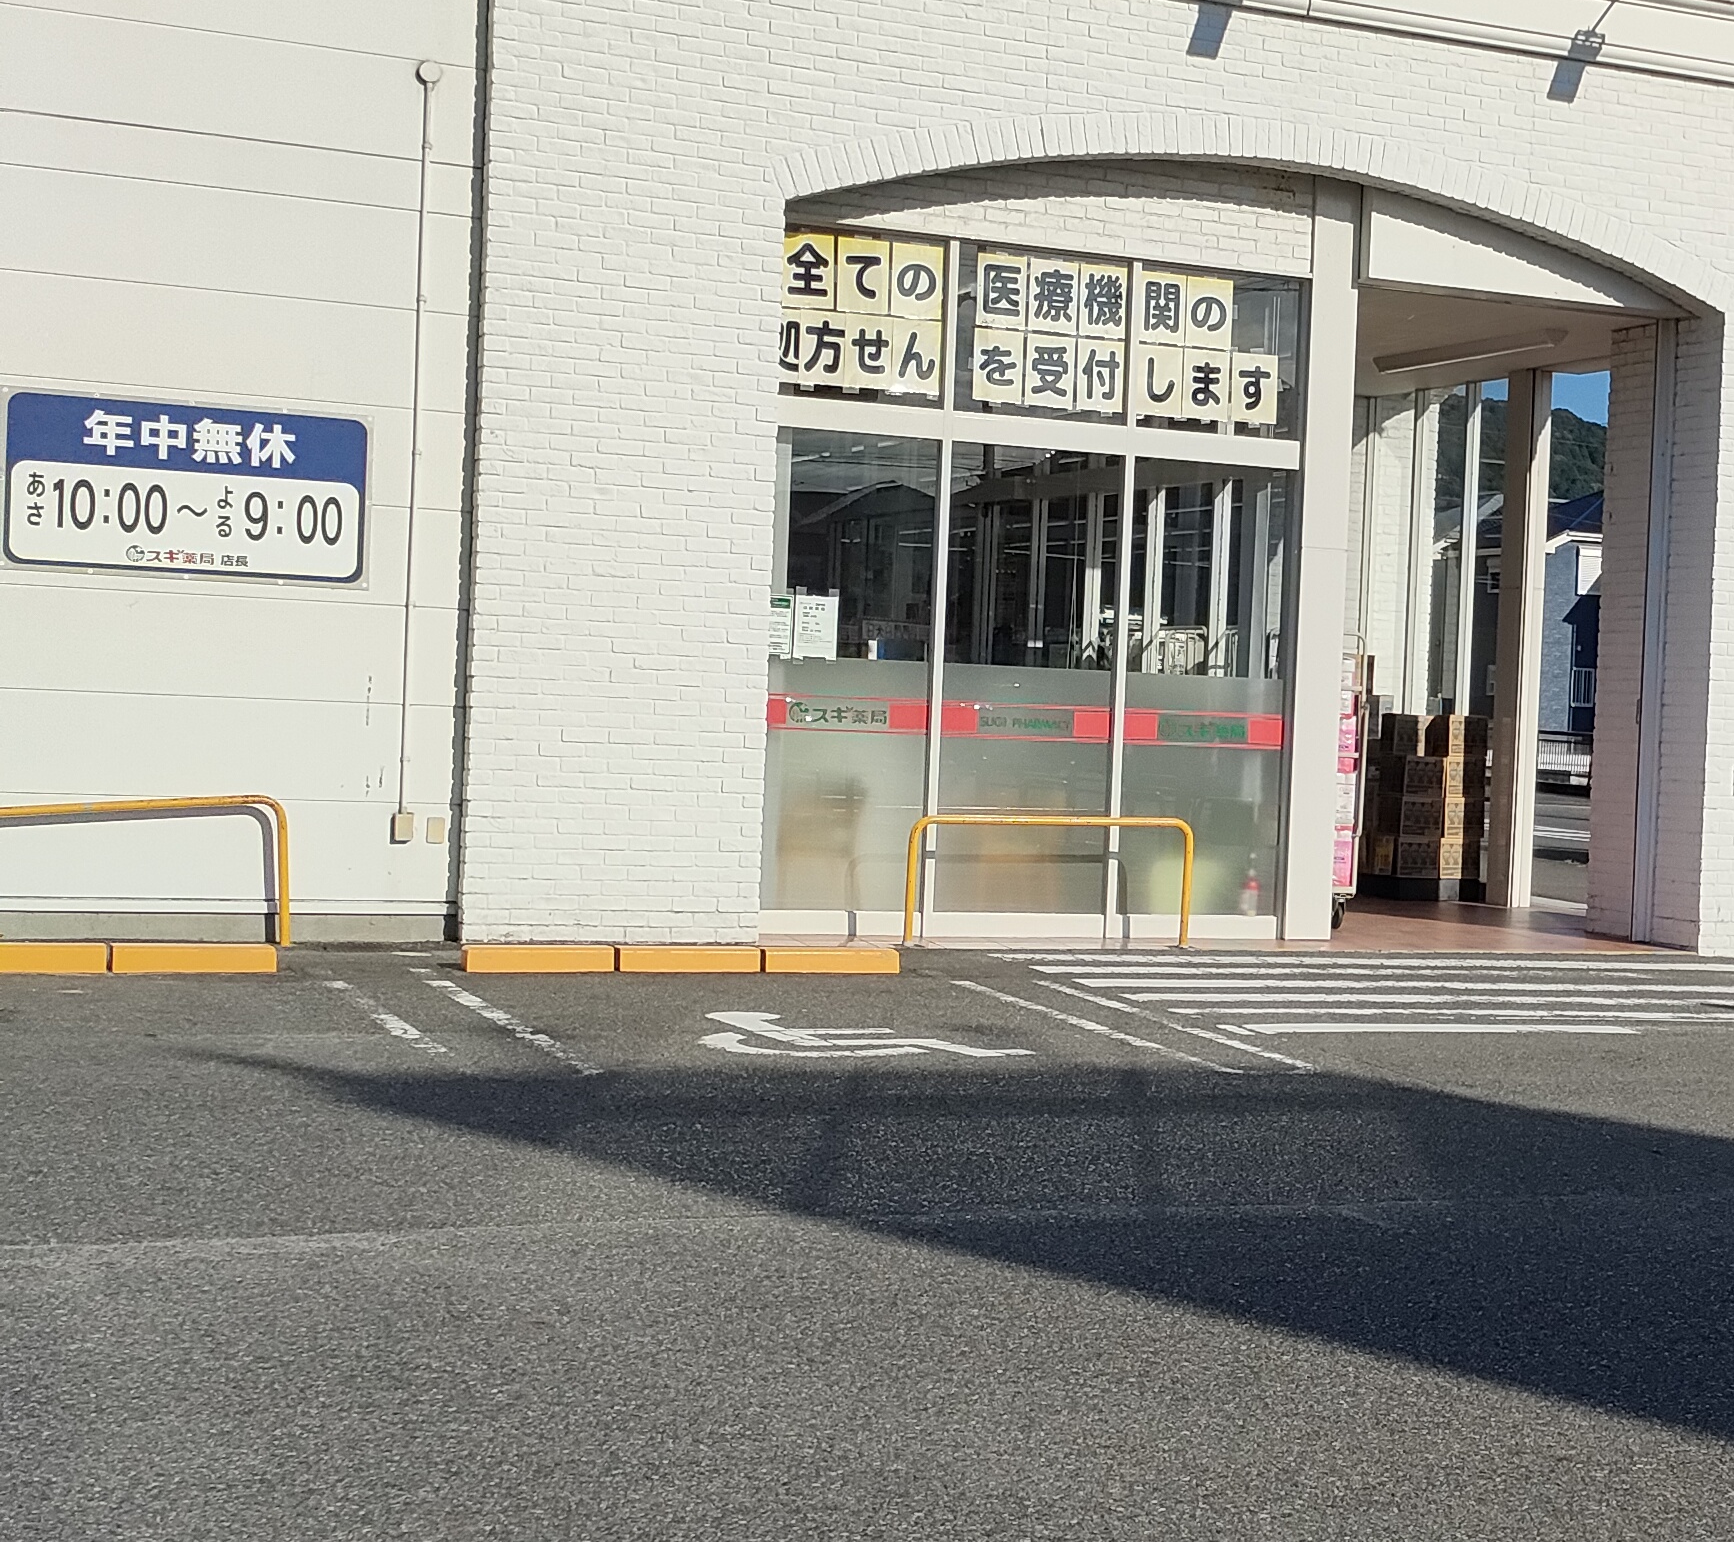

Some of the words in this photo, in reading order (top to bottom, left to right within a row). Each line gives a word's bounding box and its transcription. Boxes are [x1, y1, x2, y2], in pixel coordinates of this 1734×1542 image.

[787, 243, 936, 301] 全ての
[983, 264, 1227, 334] 医療機関の
[979, 346, 1273, 411] を受付します
[83, 409, 297, 469] 年中無休
[146, 549, 215, 566] スギ薬局
[220, 554, 249, 567] 店長
[811, 706, 888, 725] スギ薬局
